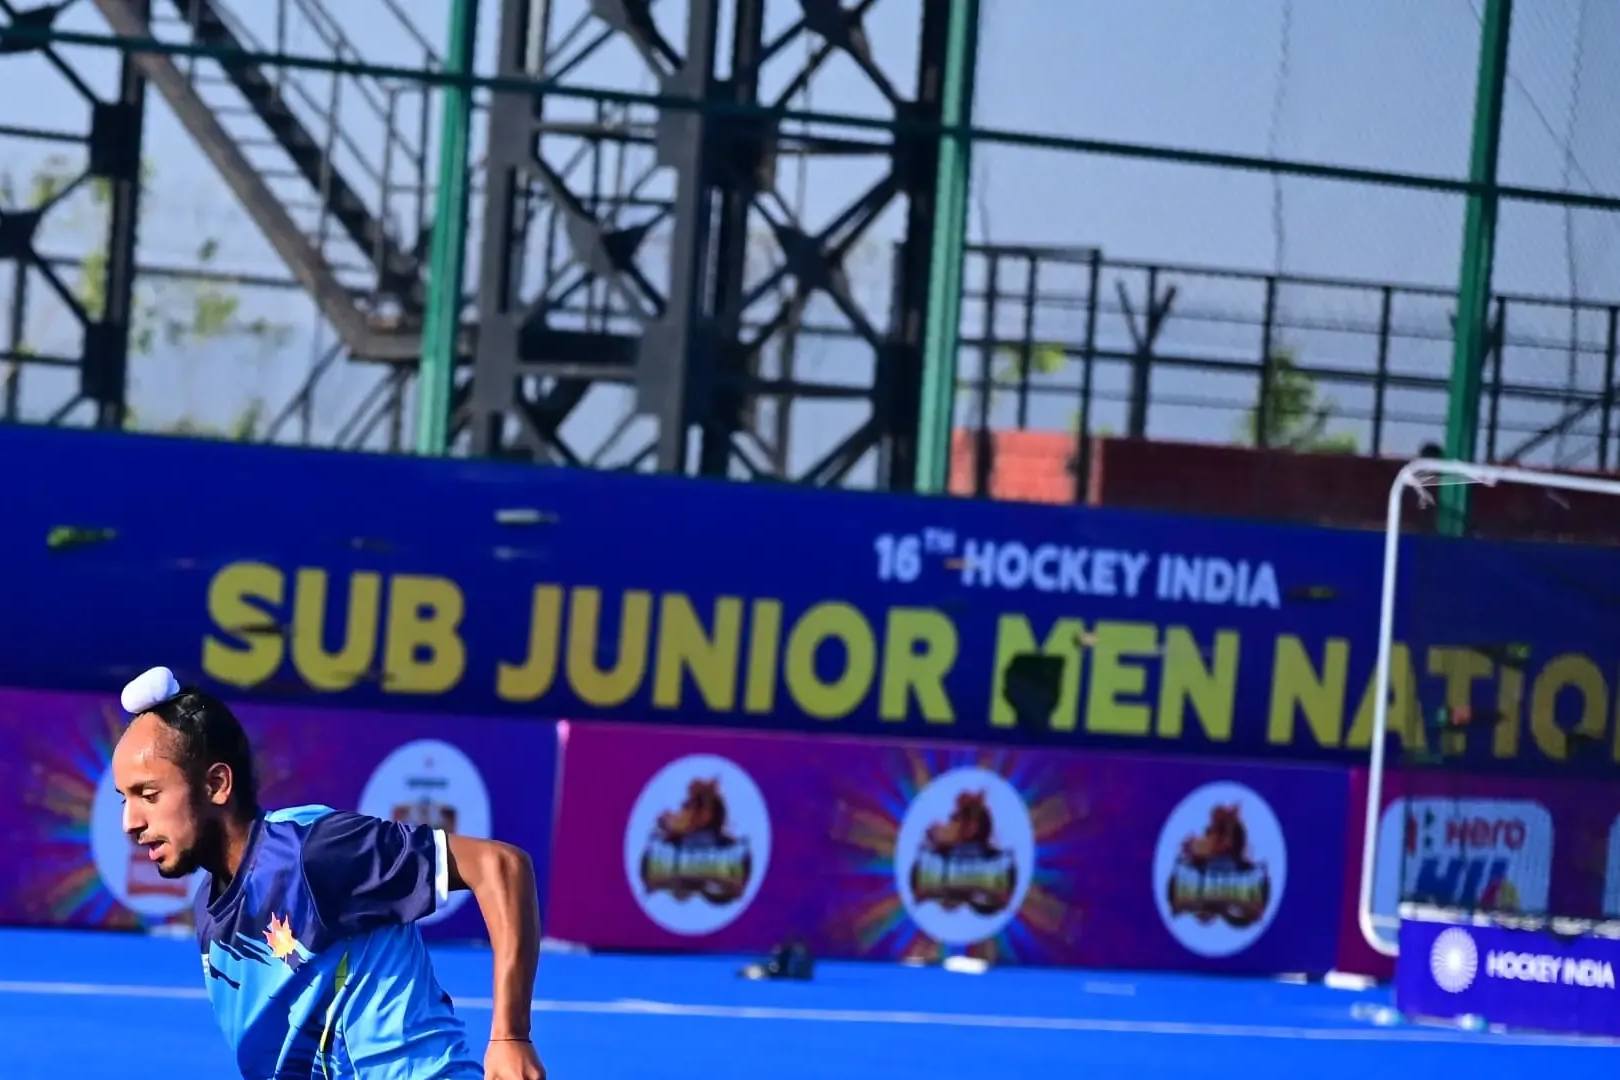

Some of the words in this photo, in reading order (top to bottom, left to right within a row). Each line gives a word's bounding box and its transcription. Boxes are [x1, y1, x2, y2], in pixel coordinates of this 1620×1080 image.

[961, 540, 1150, 598] HOCKEY
[1156, 554, 1281, 609] INDIA
[202, 561, 466, 694] SUB
[496, 584, 958, 724] JUNIOR
[989, 613, 1240, 742] MEN
[1266, 633, 1620, 762] NATIO
[1445, 816, 1527, 849] Hero
[1485, 949, 1562, 983] HOCKEY
[1561, 957, 1616, 989] INDIA
